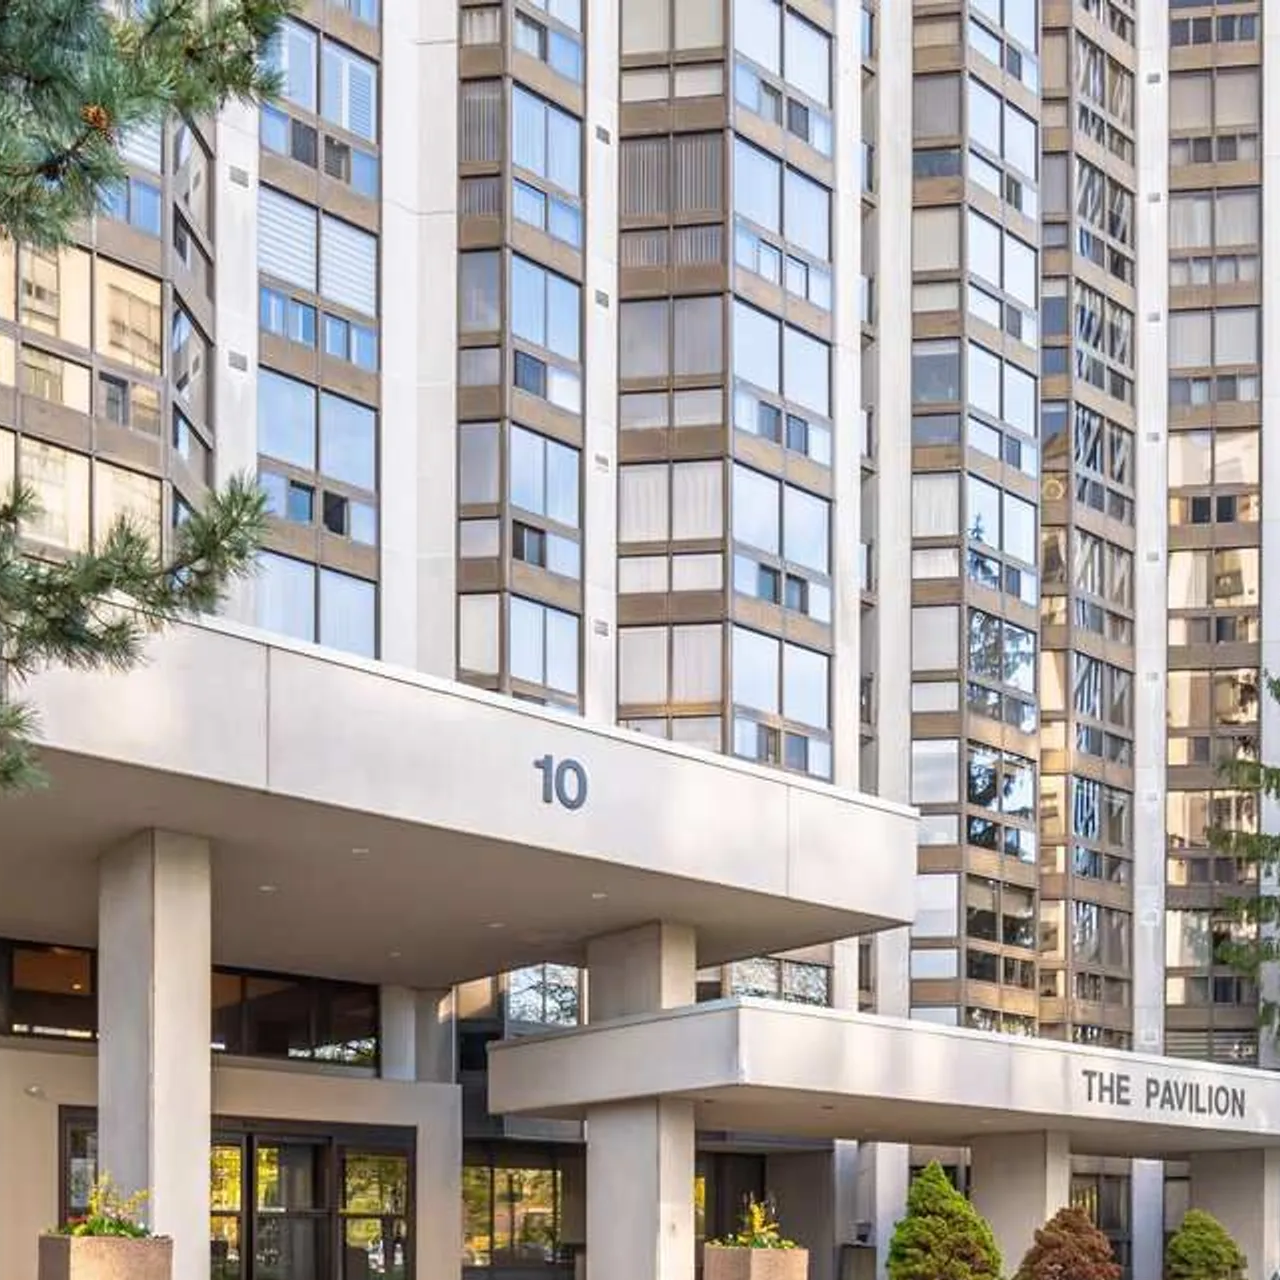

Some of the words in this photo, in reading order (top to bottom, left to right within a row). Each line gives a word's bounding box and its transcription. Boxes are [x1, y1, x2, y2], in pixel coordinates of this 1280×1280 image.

[533, 754, 588, 811] 10
[1081, 1069, 1131, 1106] THE
[1145, 1077, 1246, 1118] PAVILION
